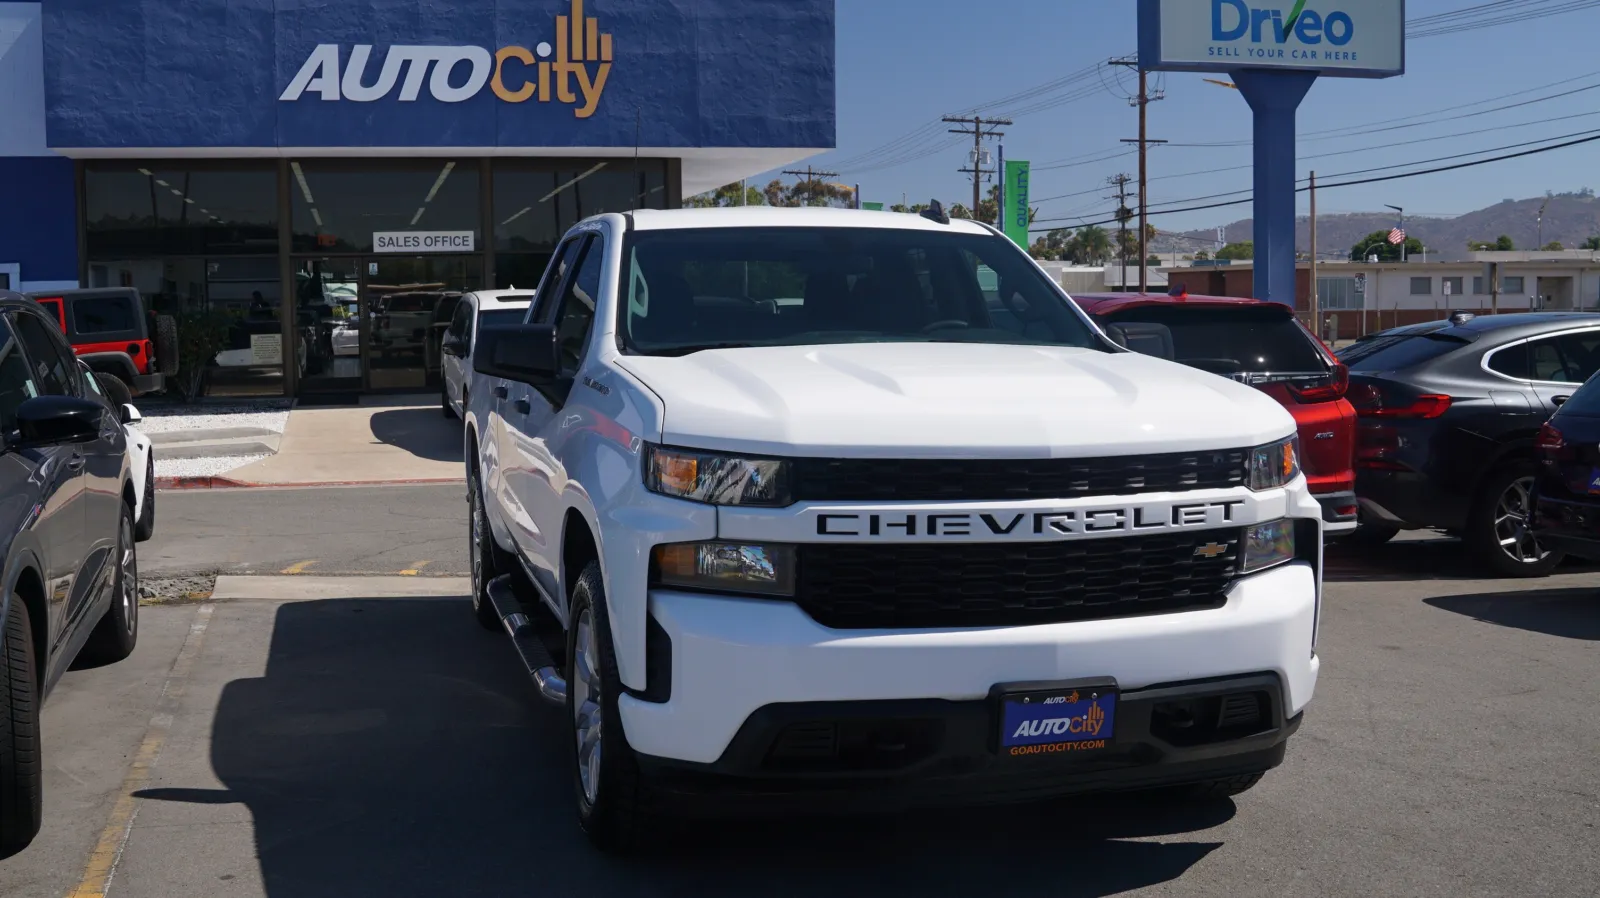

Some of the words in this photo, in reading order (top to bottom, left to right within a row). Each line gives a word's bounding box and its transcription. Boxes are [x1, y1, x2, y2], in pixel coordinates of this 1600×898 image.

[1211, 0, 1354, 46] Driveo
[1208, 47, 1240, 56] SELL
[1248, 48, 1284, 58] YOUR
[1291, 50, 1318, 60] CAR
[1324, 51, 1358, 61] HERE
[378, 236, 420, 248] SALES
[424, 235, 470, 247] OFFICE
[816, 500, 1245, 535] CHEVROLET
[1010, 740, 1105, 756] GOAUTOCITY.COM
